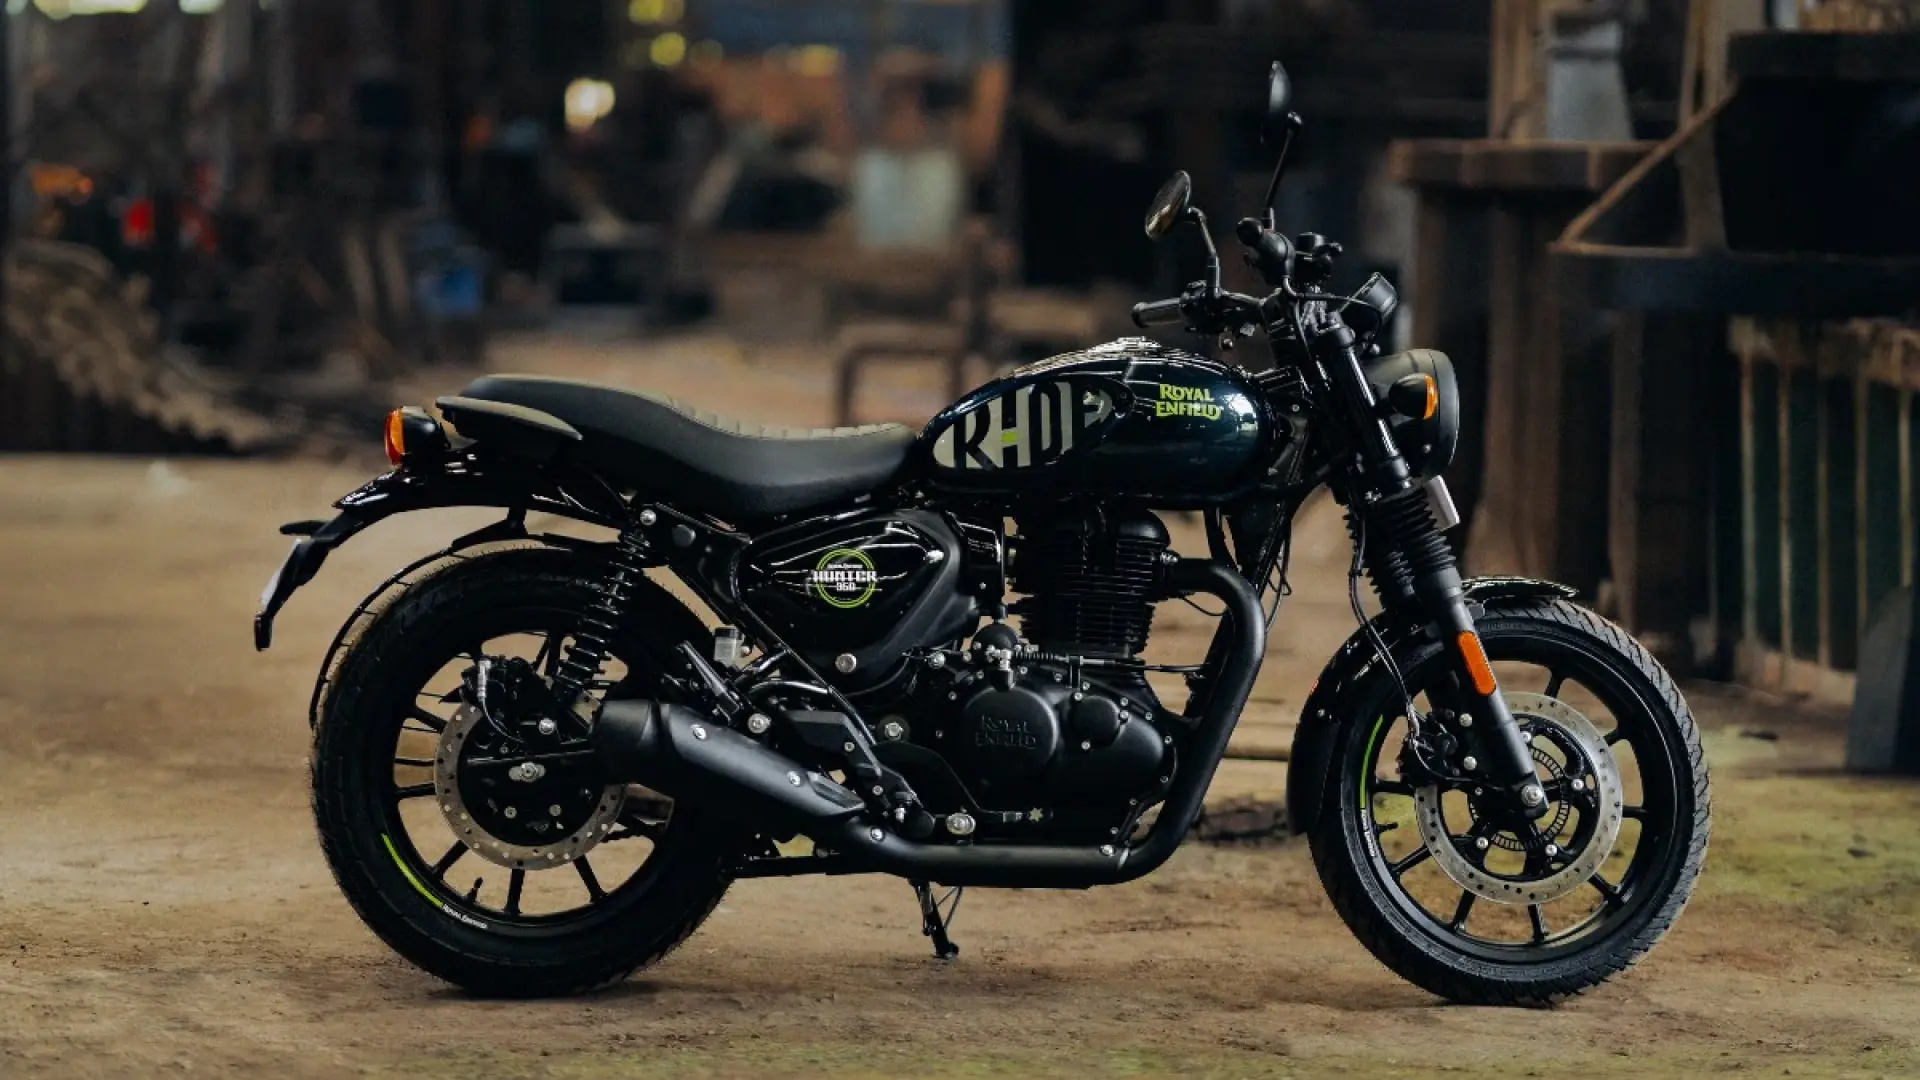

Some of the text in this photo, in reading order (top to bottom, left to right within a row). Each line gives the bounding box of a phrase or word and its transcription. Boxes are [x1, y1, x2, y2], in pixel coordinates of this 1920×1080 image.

[1159, 383, 1215, 402] ROYAL
[1155, 401, 1223, 421] ENFIELD
[813, 570, 878, 583] HUNTER
